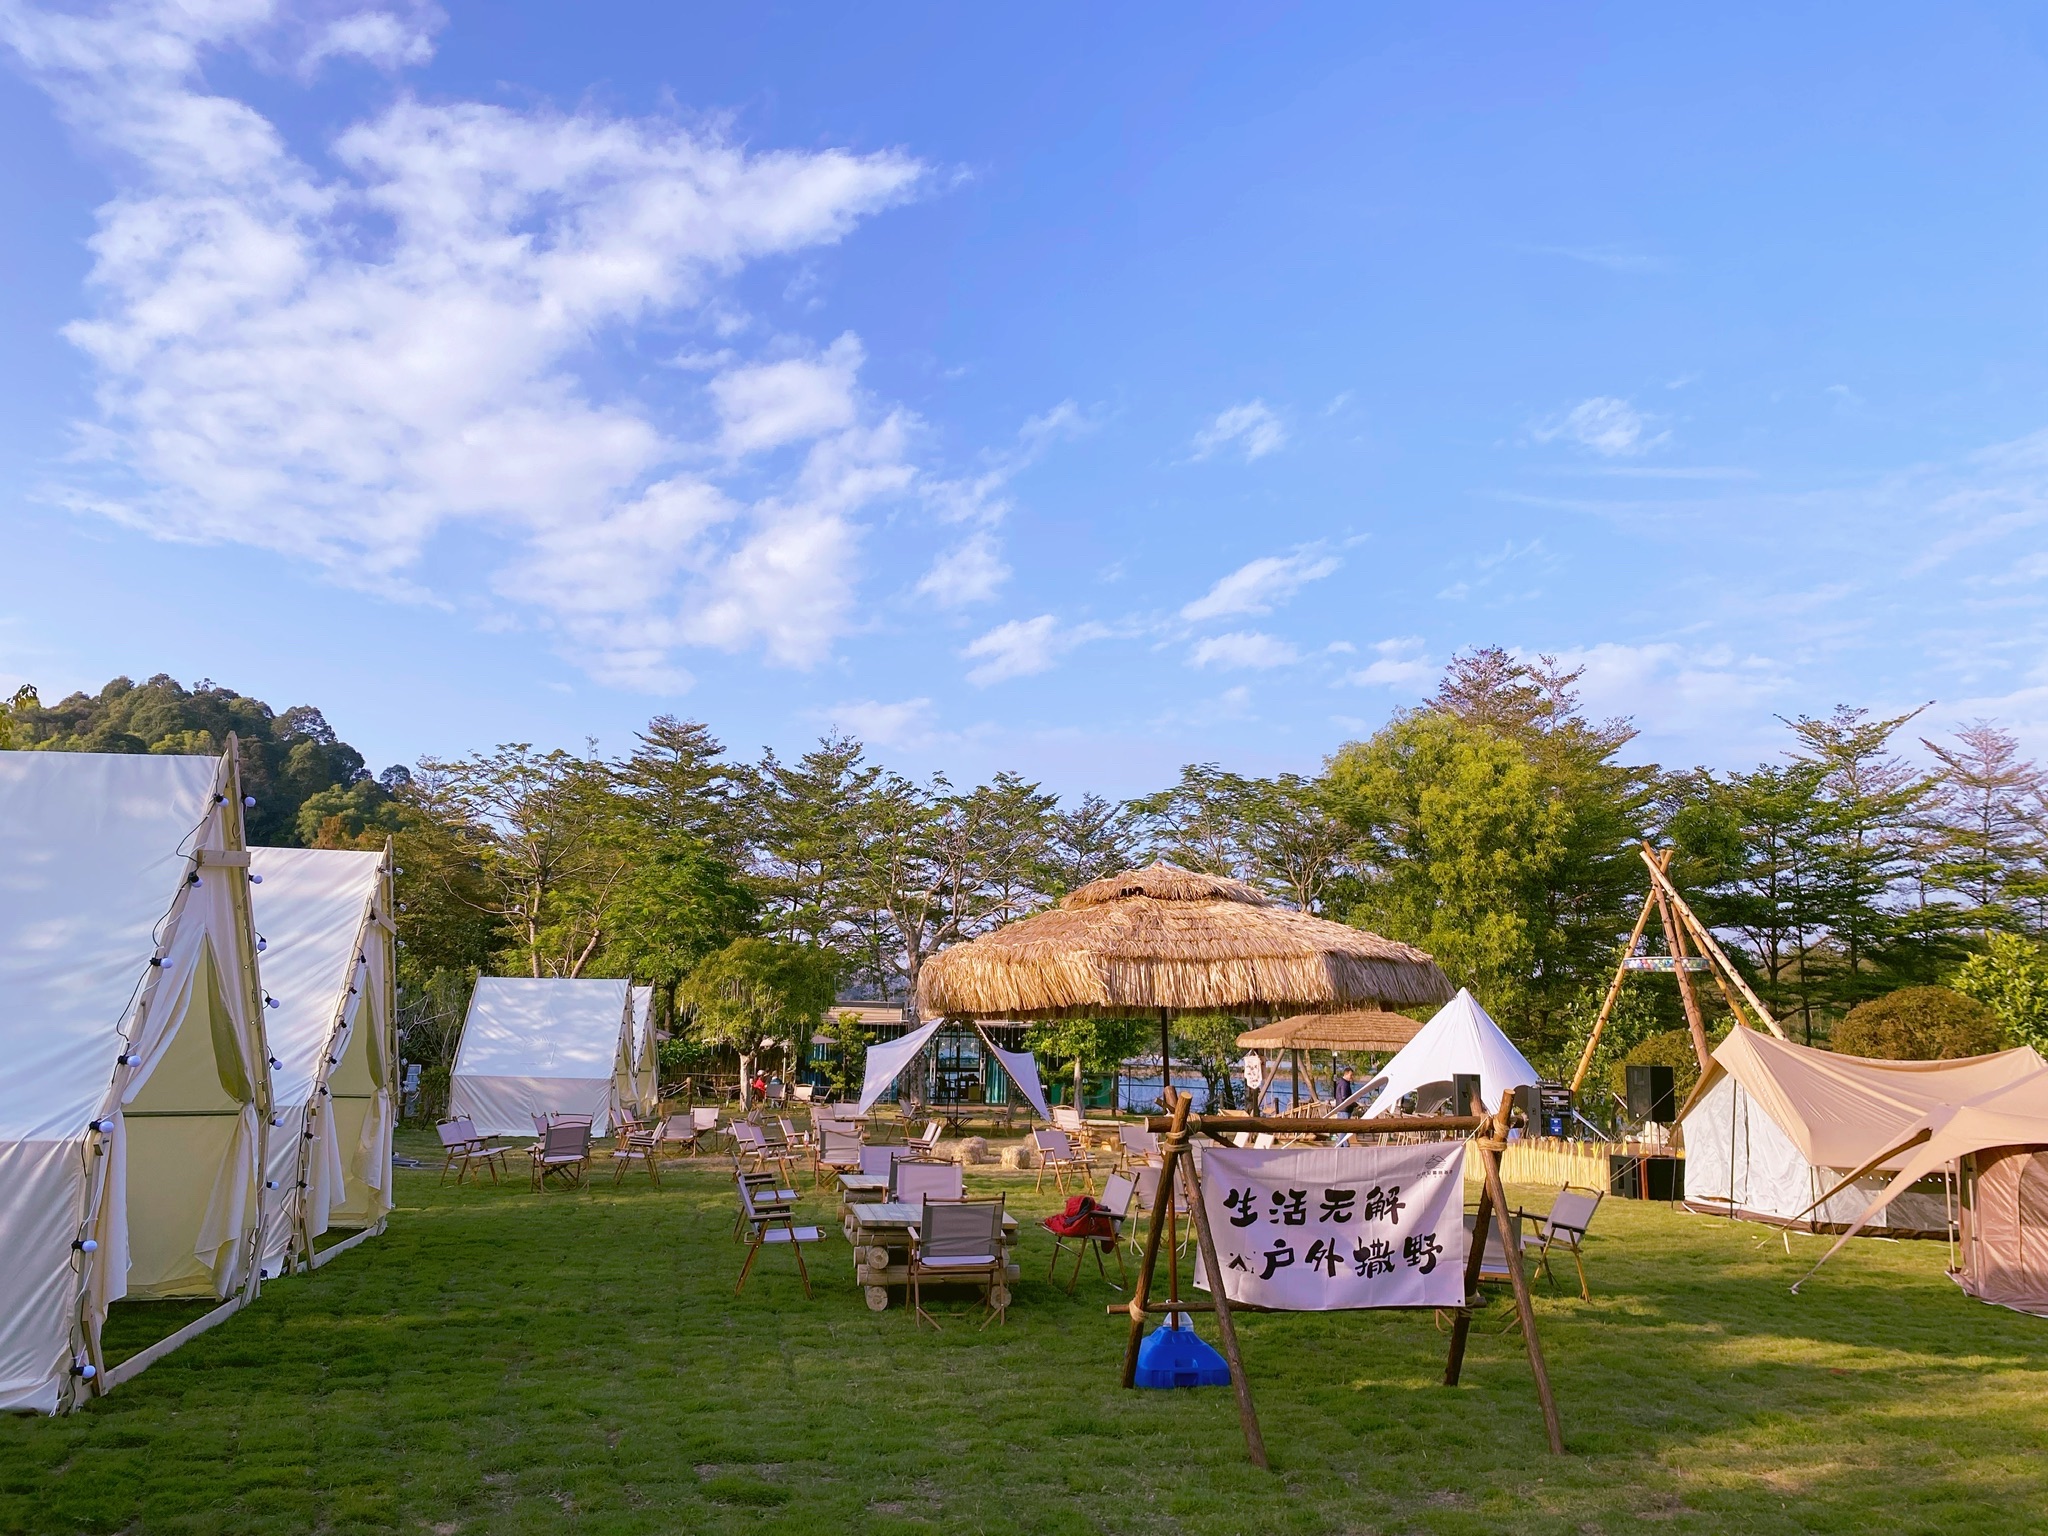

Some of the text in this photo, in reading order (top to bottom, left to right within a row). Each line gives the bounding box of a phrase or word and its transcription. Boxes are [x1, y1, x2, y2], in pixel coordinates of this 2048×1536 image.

[1223, 1186, 1406, 1227] 生活无解
[1259, 1232, 1443, 1280] 户外撒野
